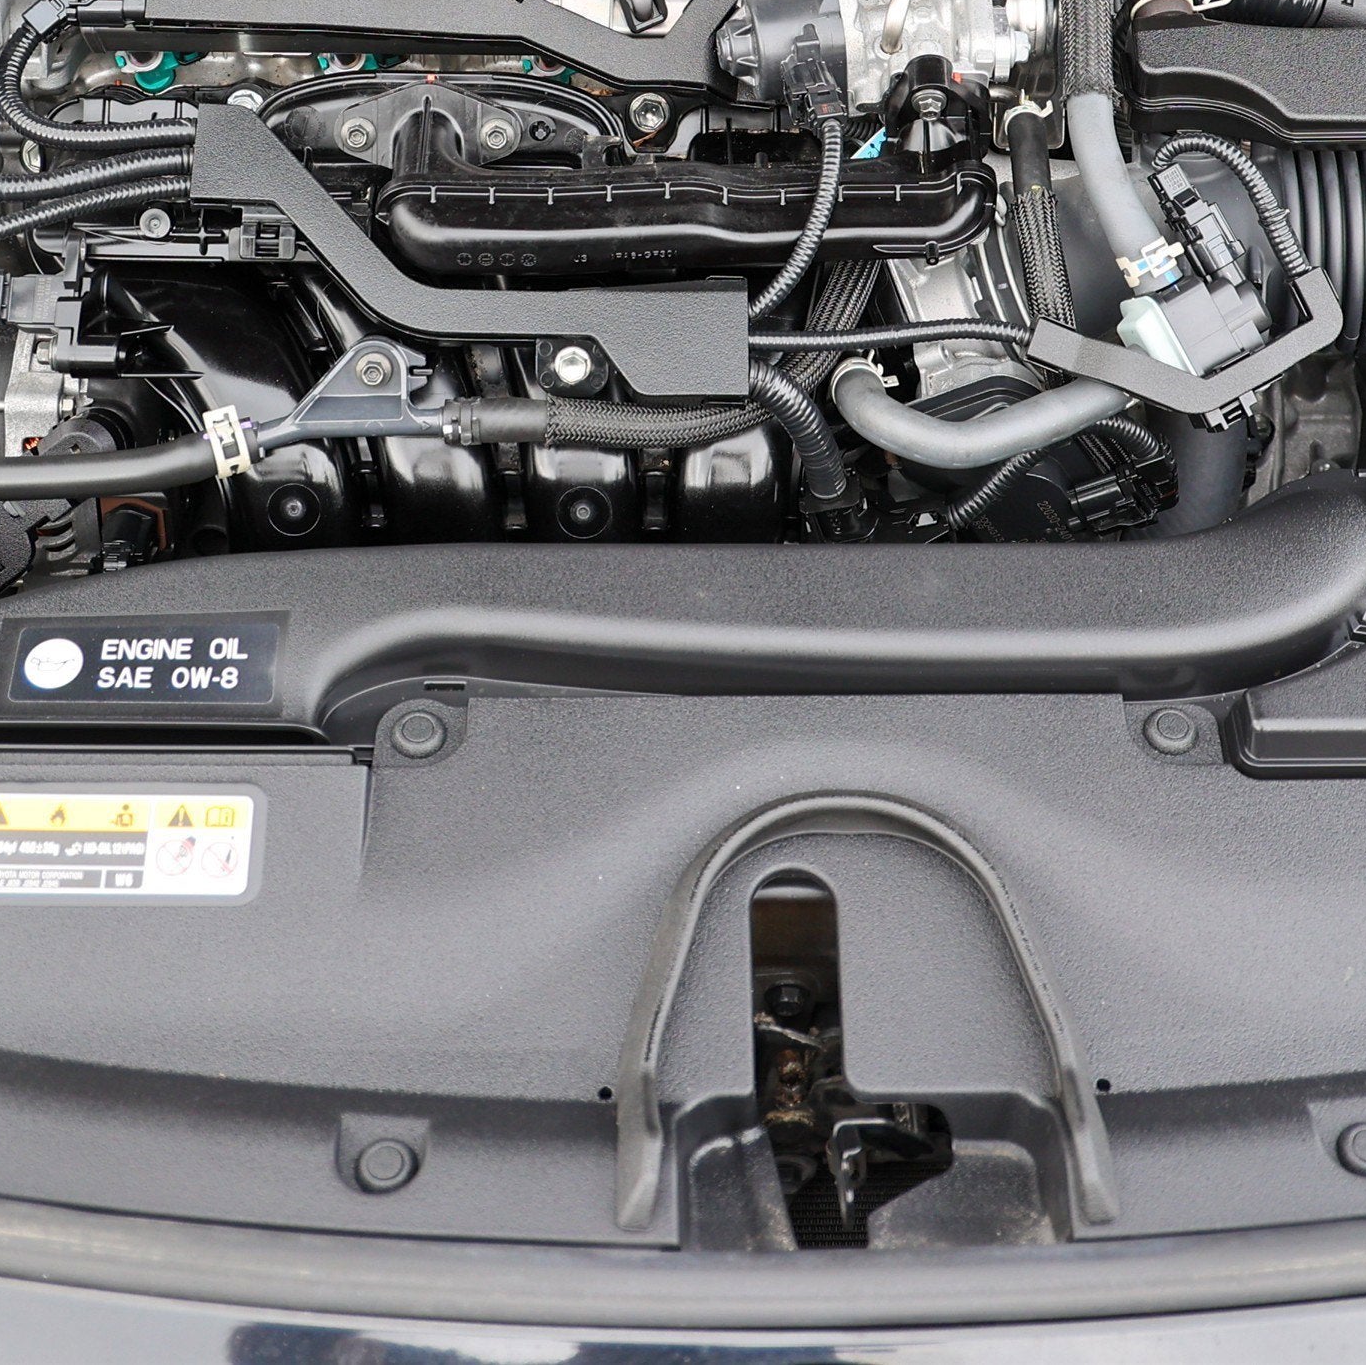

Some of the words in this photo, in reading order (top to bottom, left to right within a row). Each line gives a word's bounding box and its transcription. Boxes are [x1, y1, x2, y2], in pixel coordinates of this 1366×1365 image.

[100, 638, 193, 661] ENGINE
[209, 637, 248, 660] OIL
[97, 666, 152, 689] SAE
[171, 666, 239, 689] 0W-8
[19, 871, 40, 879] MOTOR
[42, 871, 84, 880] CORPORATION
